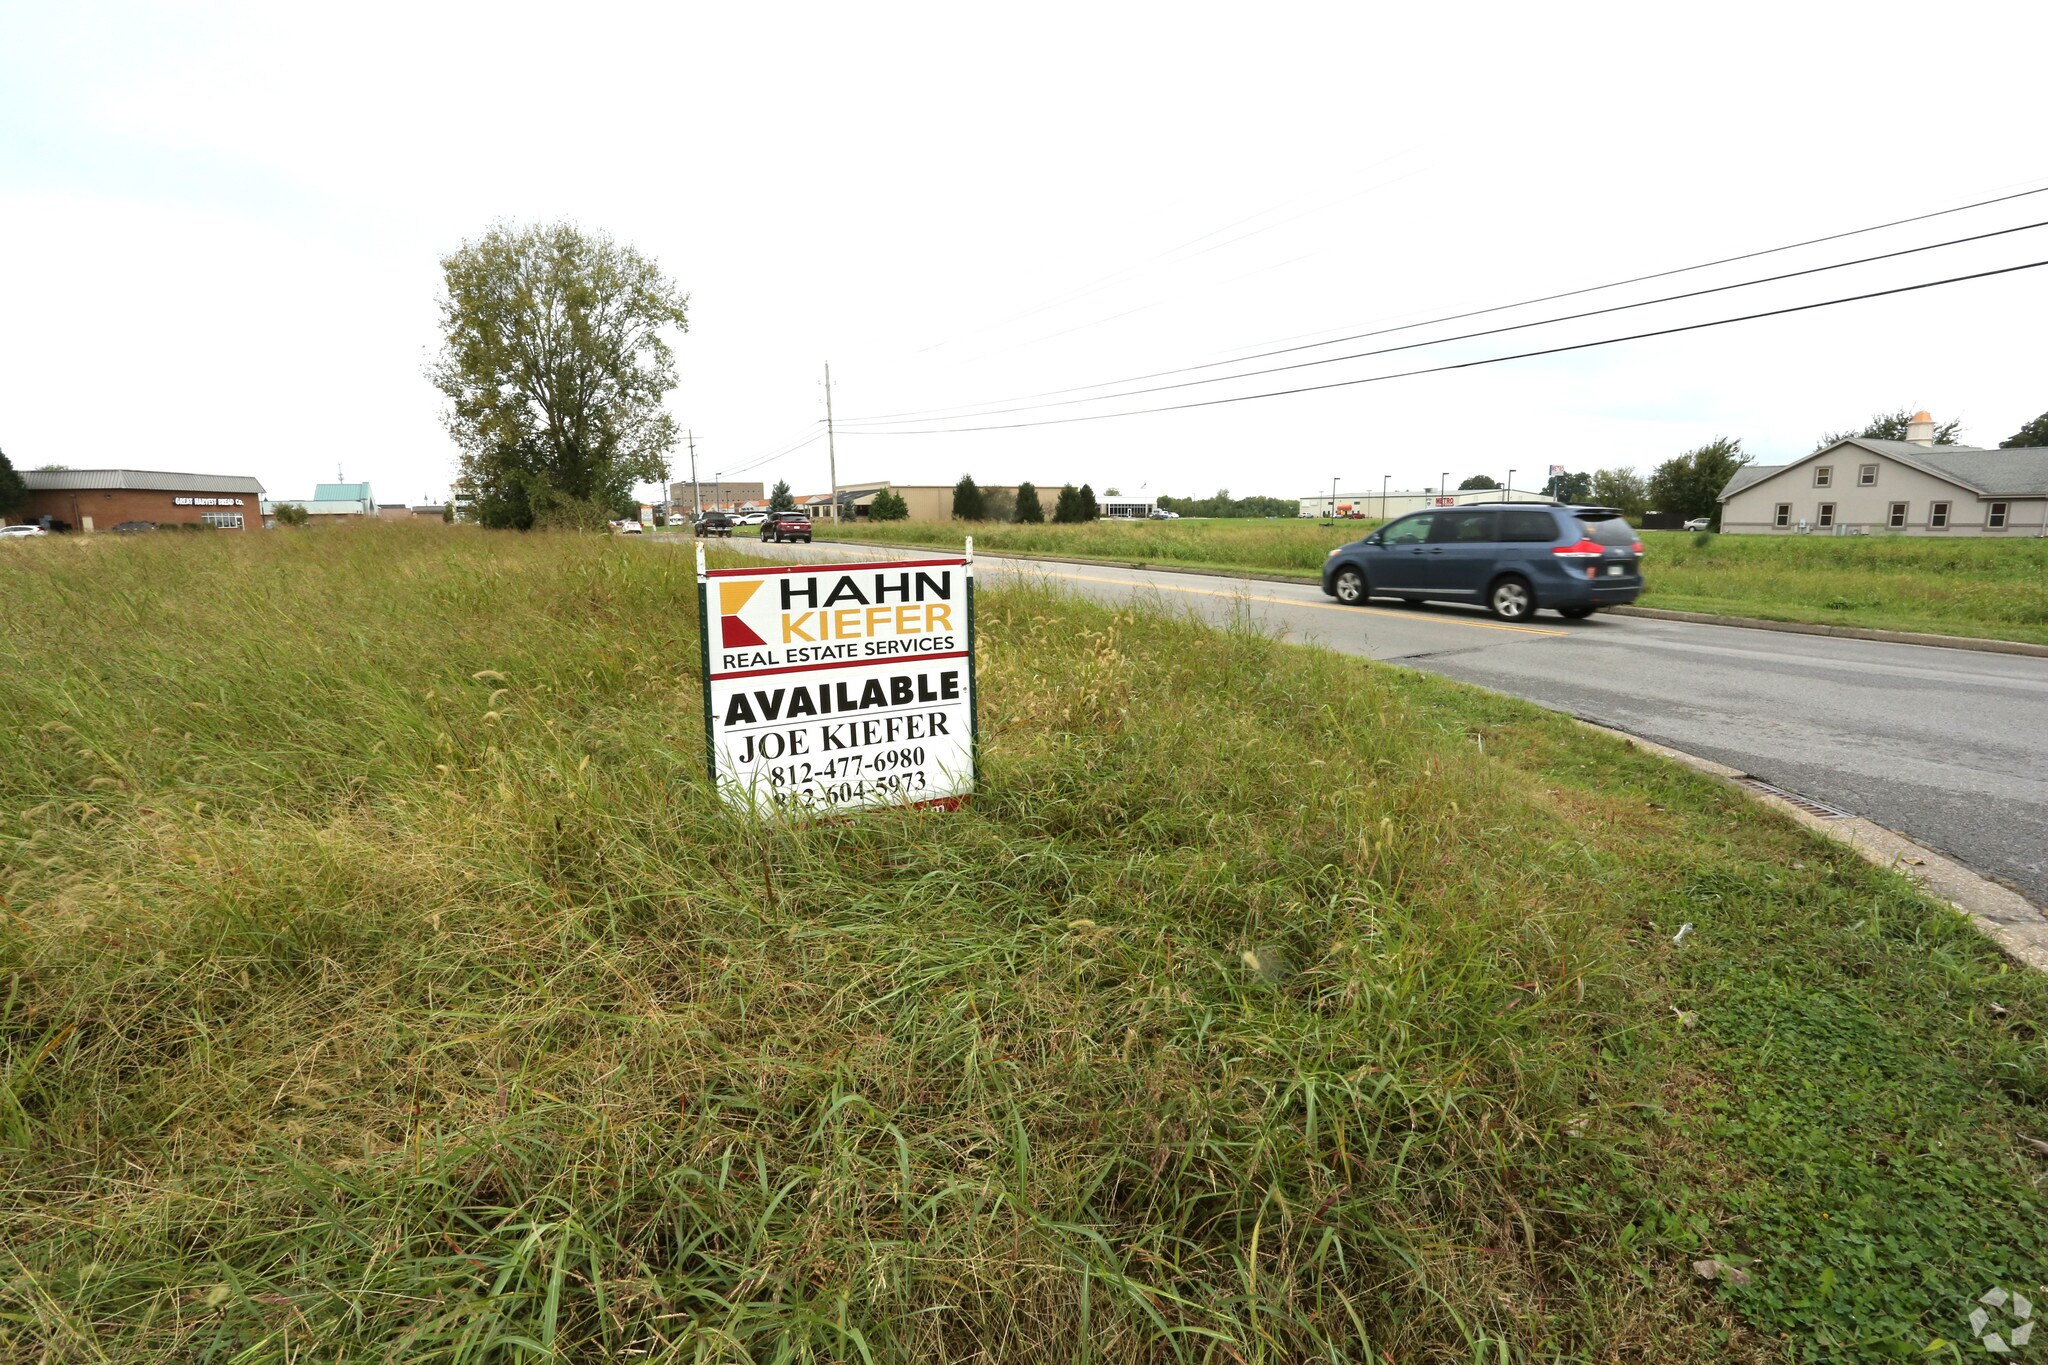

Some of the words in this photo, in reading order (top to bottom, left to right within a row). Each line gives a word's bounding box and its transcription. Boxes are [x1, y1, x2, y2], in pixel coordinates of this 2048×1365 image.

[175, 497, 193, 505] GREAT
[194, 497, 217, 506] HARVEST
[217, 498, 235, 506] BREAD
[1435, 497, 1454, 505] METRO
[780, 571, 951, 610] HAHN
[781, 603, 953, 644] KIEFER
[723, 650, 780, 669] REAL
[786, 643, 858, 664] ESTATE
[864, 636, 955, 656] SERVICES
[724, 670, 960, 726] AVAILABLE
[739, 728, 810, 763] JOE
[821, 711, 951, 752] KIEFER
[771, 746, 925, 787] 812-477-6980
[774, 770, 926, 809] 82-604-5973
